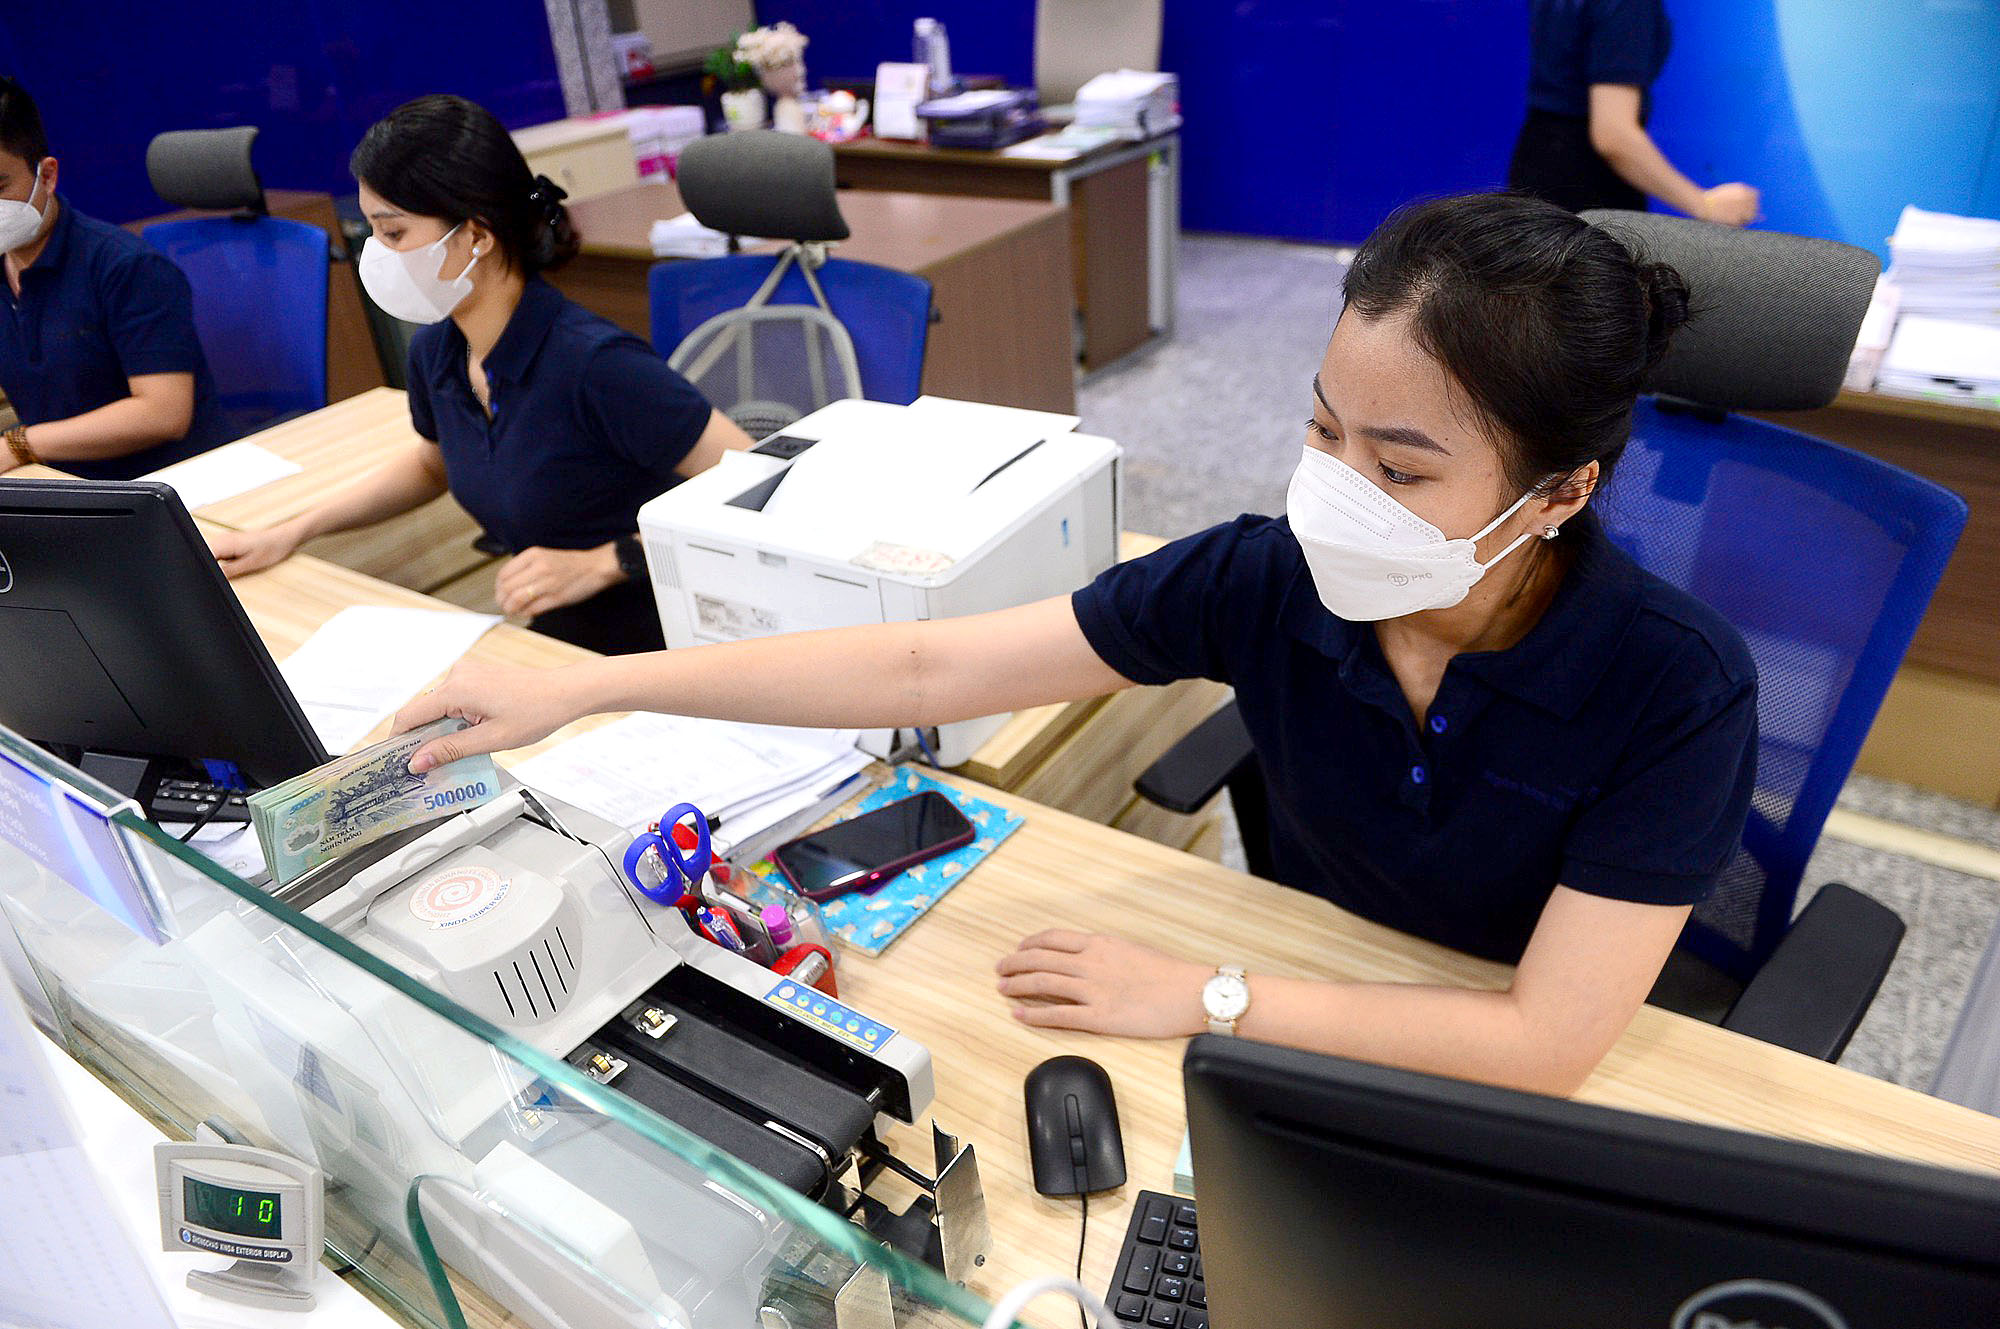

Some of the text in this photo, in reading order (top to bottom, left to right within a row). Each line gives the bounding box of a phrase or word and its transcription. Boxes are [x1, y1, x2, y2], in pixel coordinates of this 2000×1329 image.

[423, 781, 487, 811] 500000
[438, 917, 468, 928] XINDA
[468, 900, 497, 919] SUPER
[235, 1246, 263, 1257] EXTERIOR
[263, 1249, 289, 1260] DISPLAY
